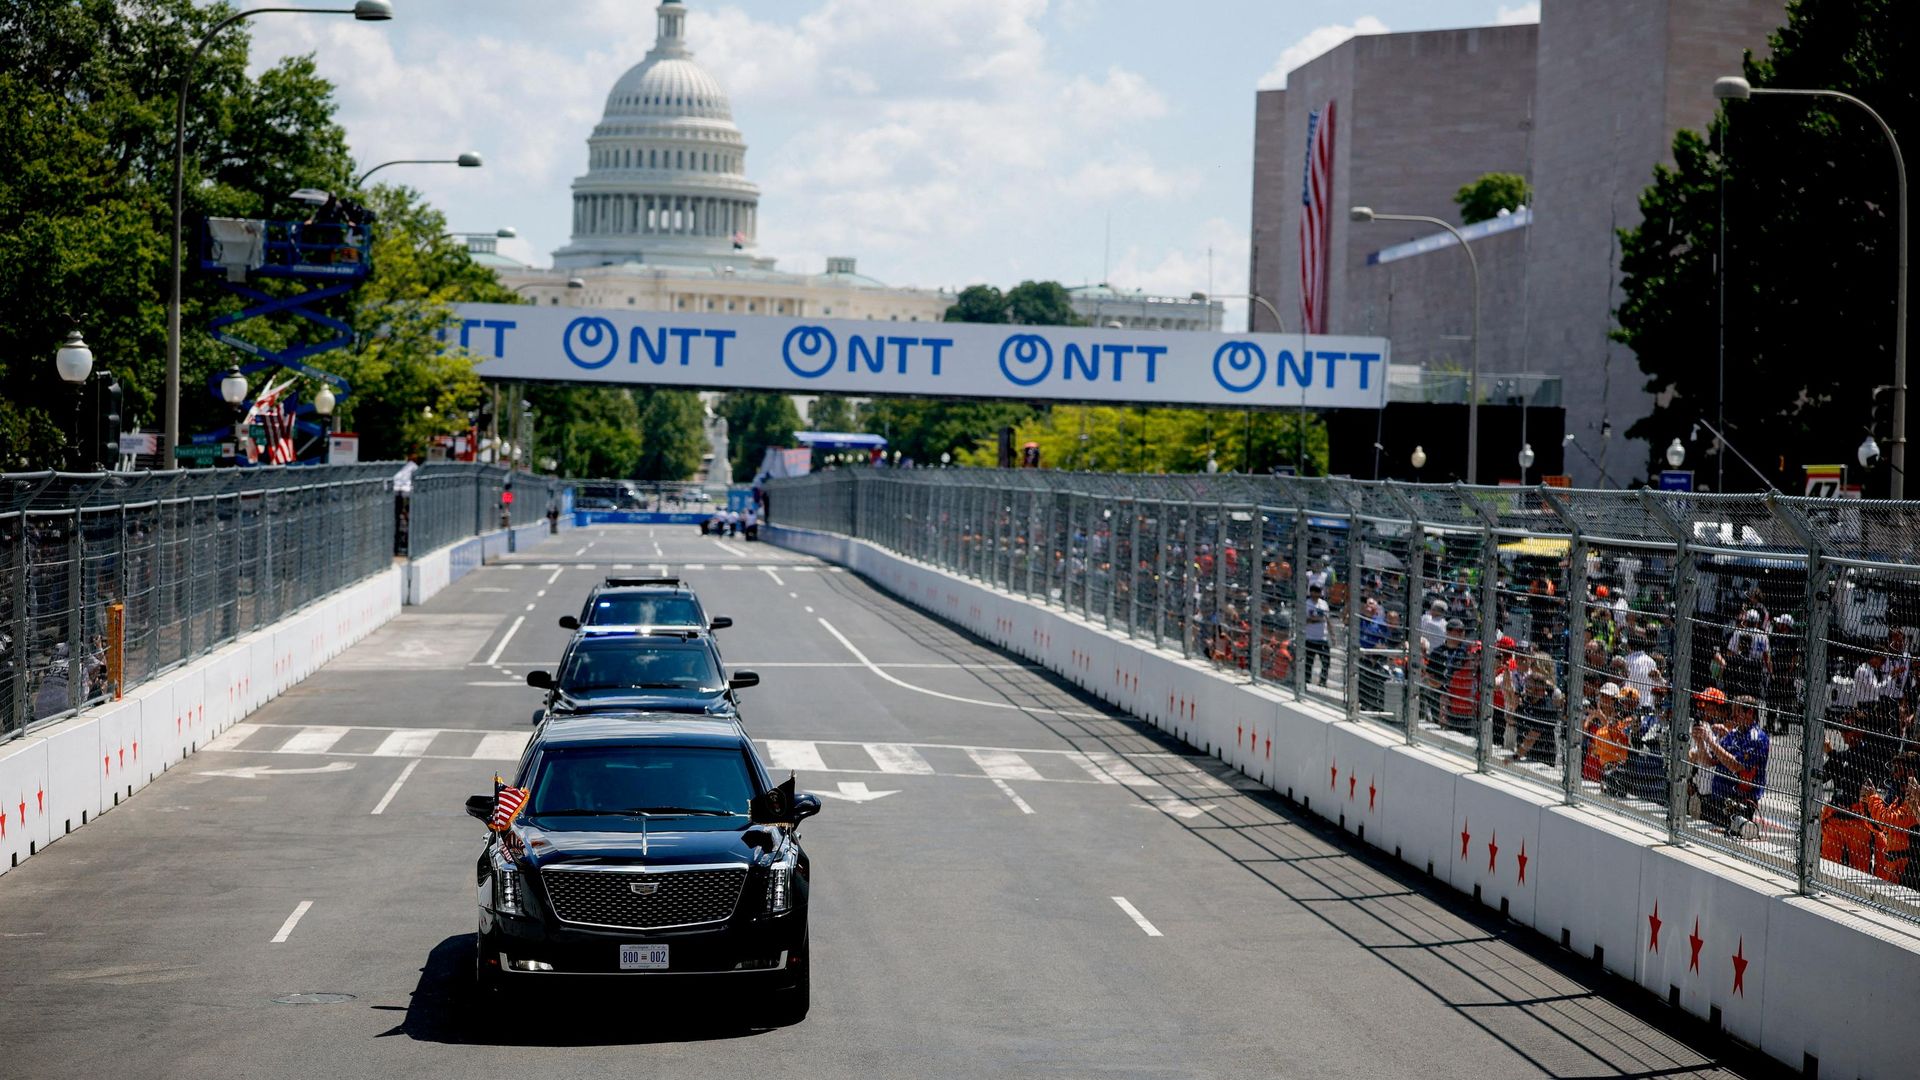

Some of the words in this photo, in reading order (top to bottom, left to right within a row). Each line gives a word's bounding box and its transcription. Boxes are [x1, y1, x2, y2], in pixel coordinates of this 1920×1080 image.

[629, 326, 737, 368] NTT
[847, 335, 955, 376] NTT
[1063, 343, 1169, 384] NTT
[1277, 349, 1383, 391] NTT
[623, 951, 639, 963] 800
[650, 951, 666, 963] 002
